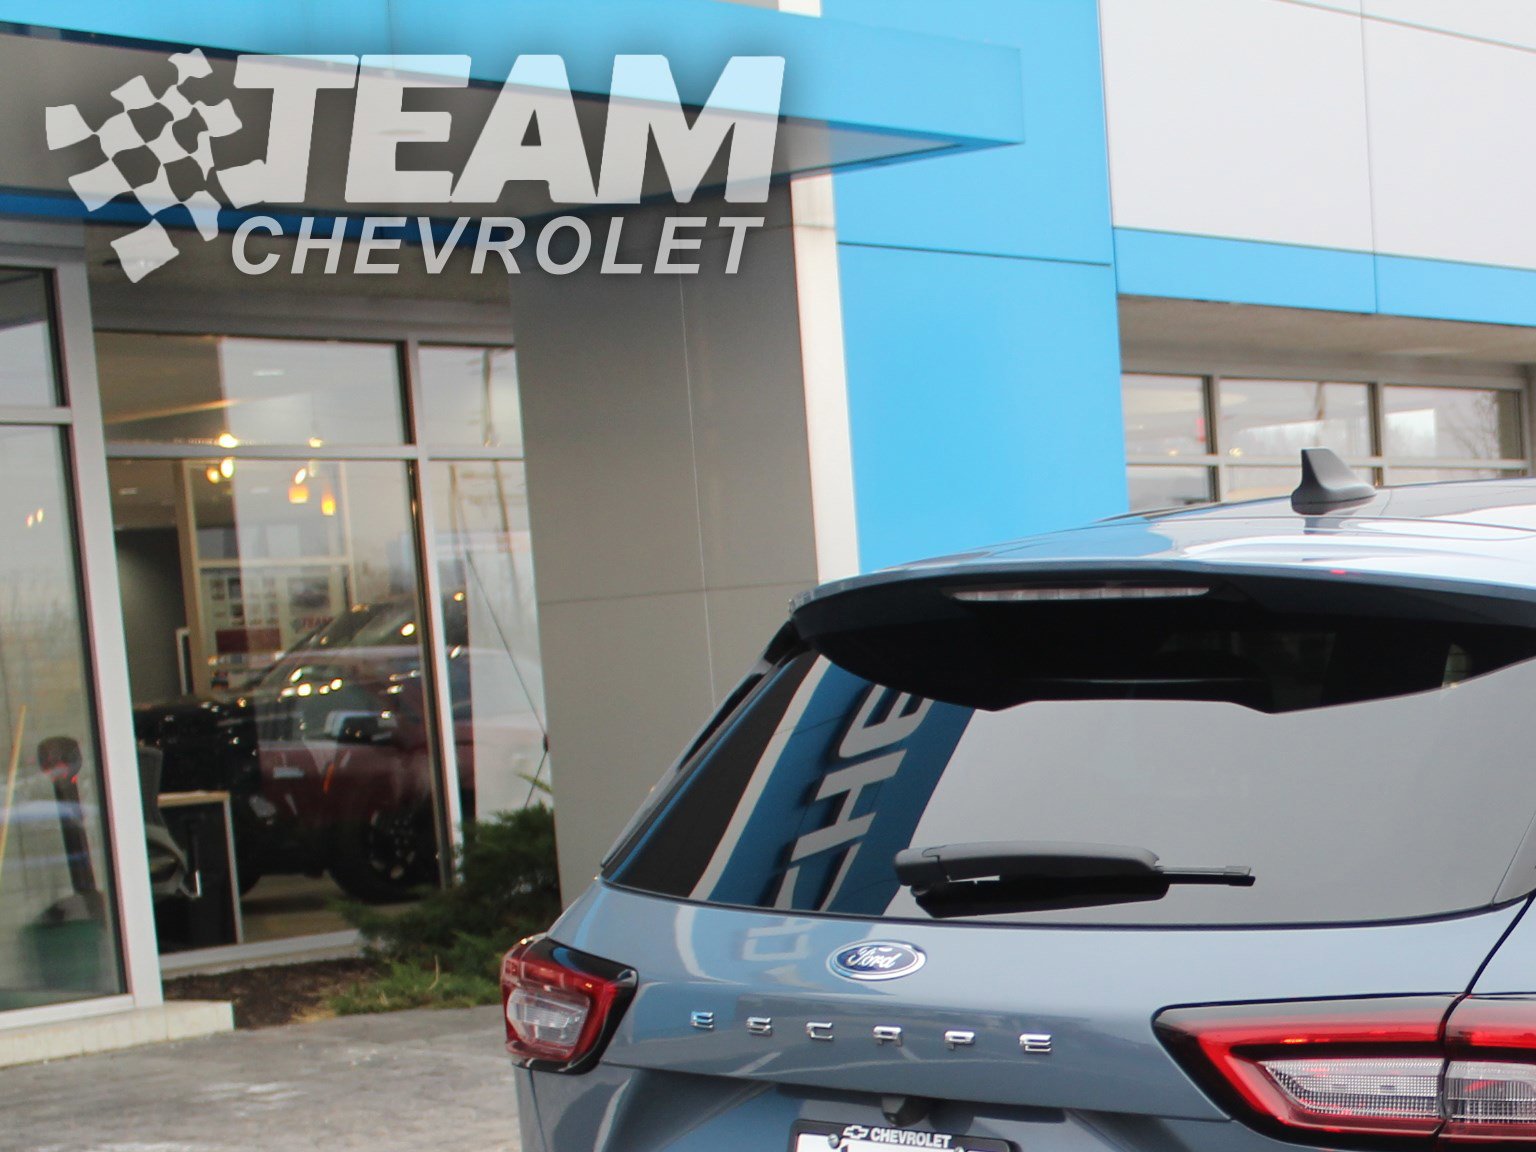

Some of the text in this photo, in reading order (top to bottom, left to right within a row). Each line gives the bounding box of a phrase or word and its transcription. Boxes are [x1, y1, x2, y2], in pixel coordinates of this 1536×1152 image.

[847, 947, 902, 969] Ford
[691, 1011, 1052, 1054] ESCAPE
[870, 1126, 952, 1149] CHEVROLET
